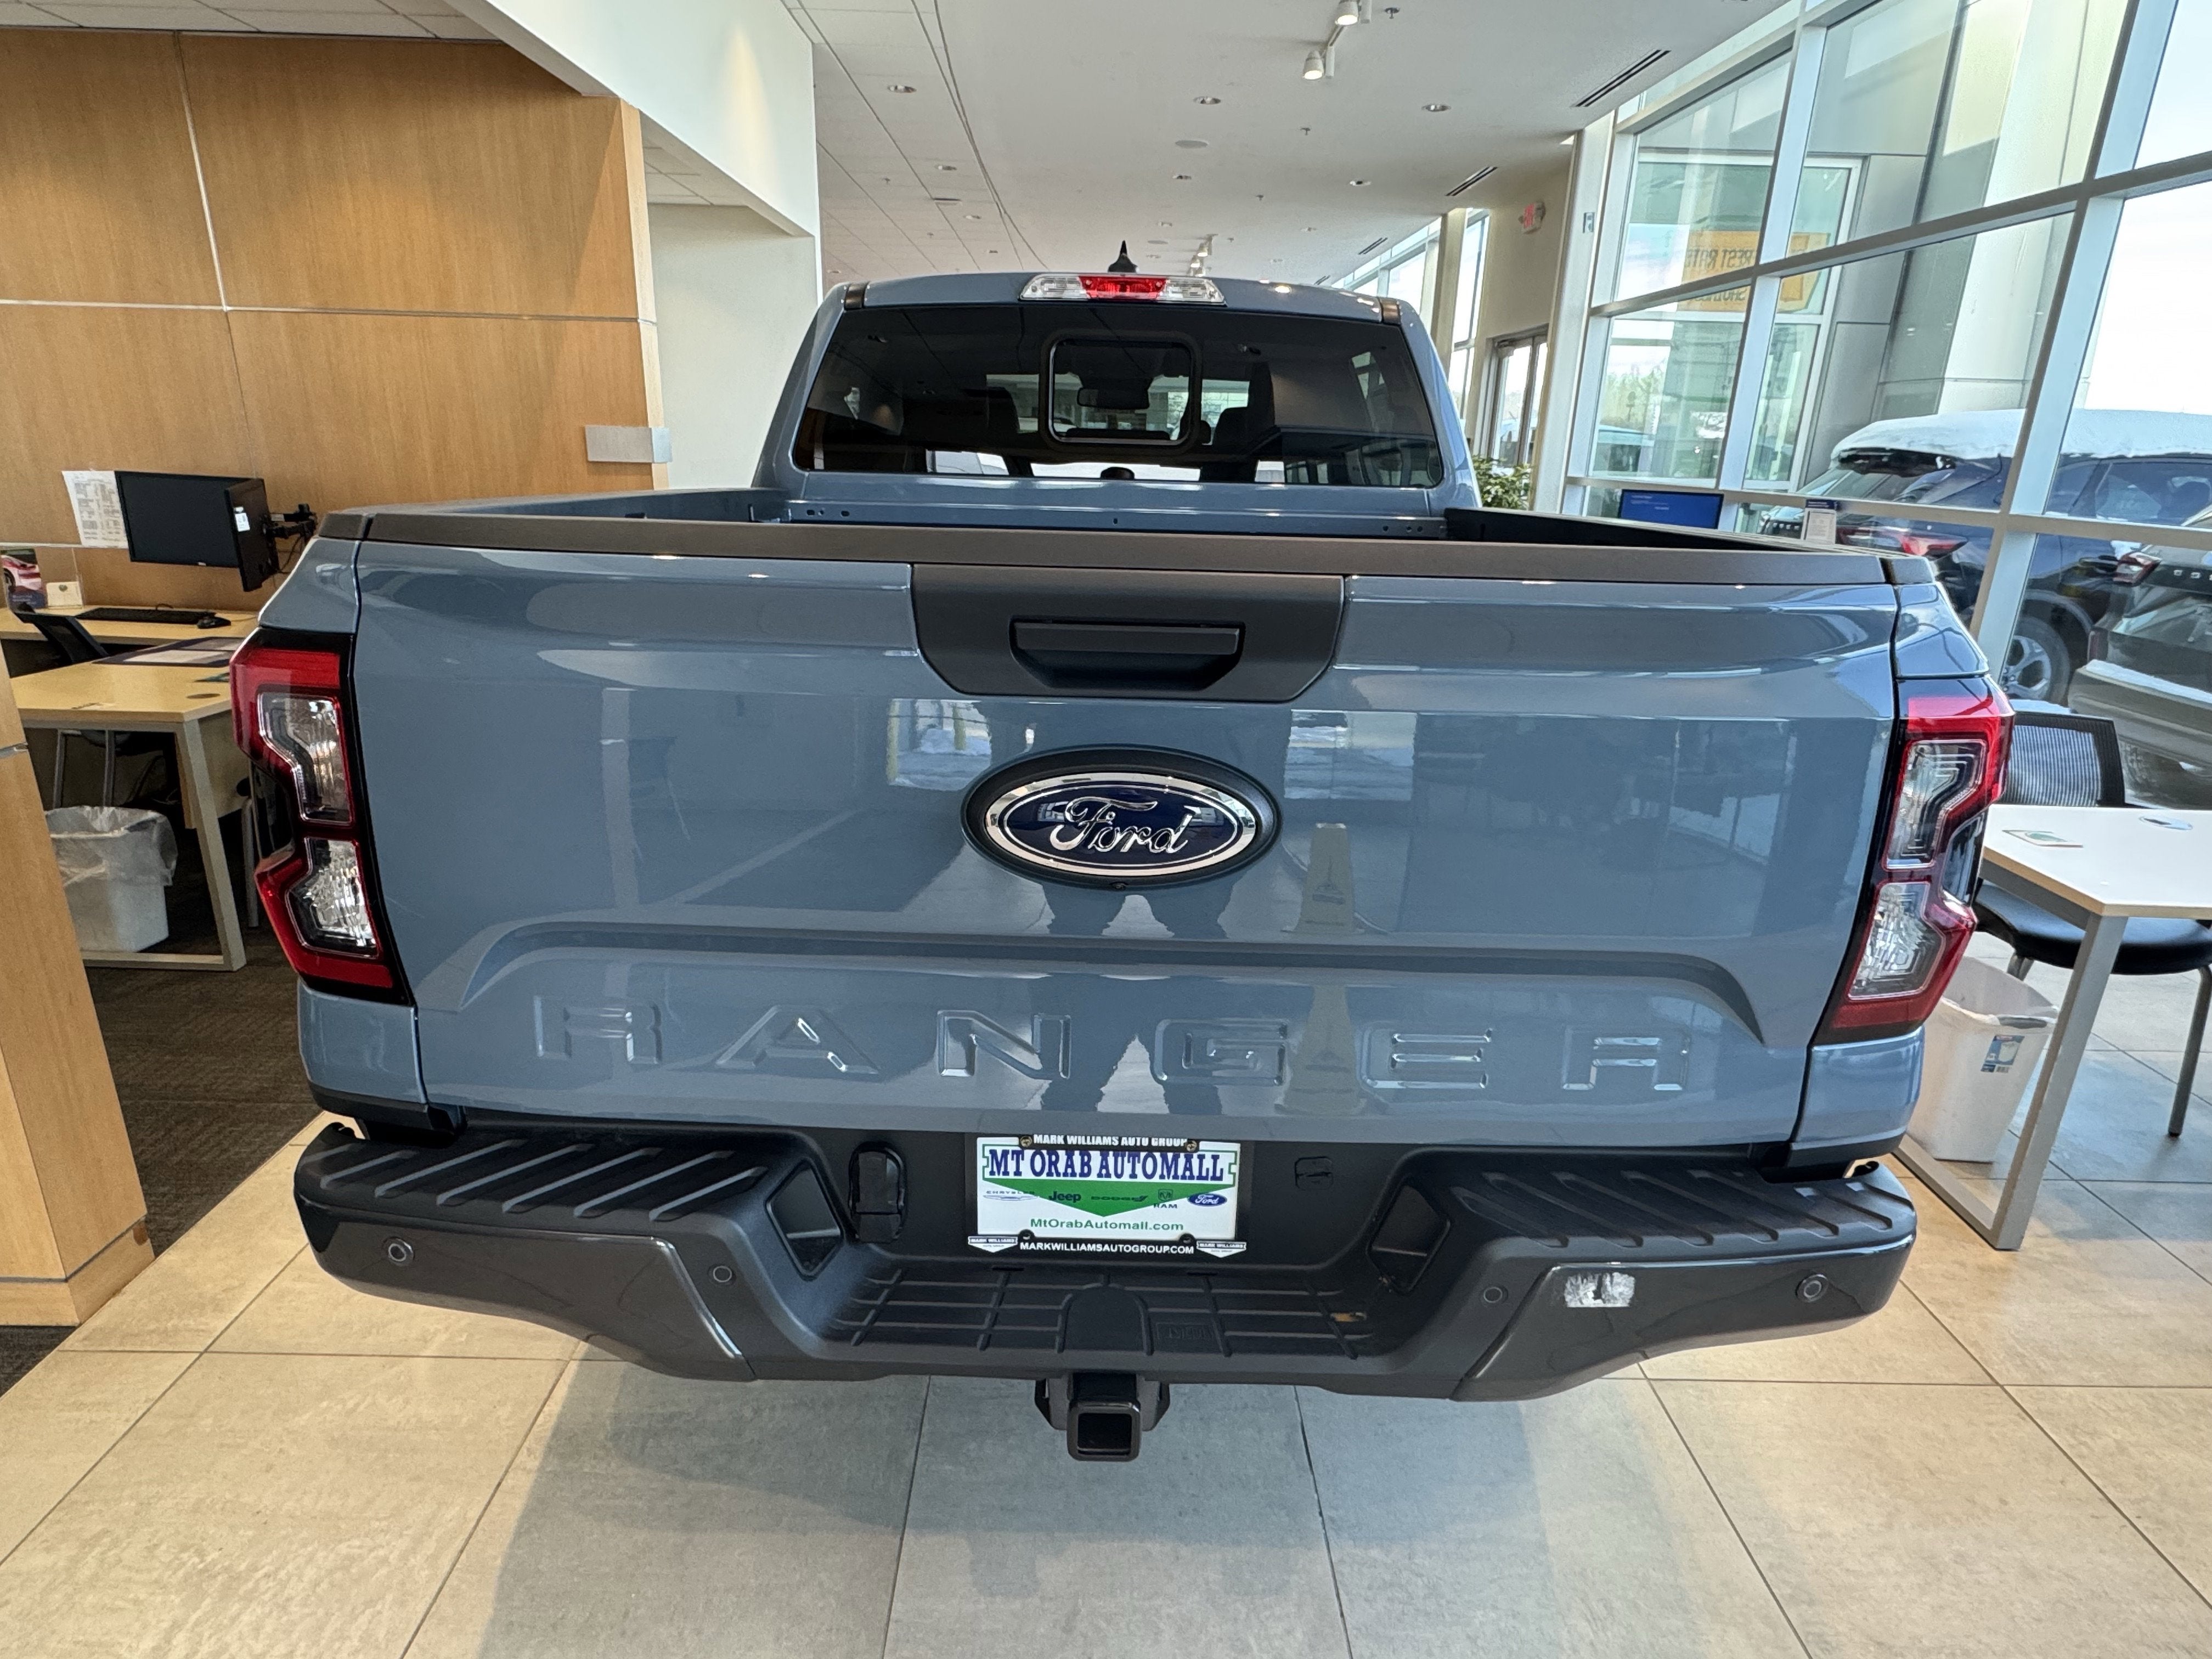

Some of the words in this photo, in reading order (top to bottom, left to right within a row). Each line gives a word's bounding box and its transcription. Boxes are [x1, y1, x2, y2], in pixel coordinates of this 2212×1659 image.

[1049, 795, 1192, 854] Ford
[533, 995, 1691, 1092] RANGER
[1033, 1134, 1064, 1144] MARK
[1066, 1135, 1119, 1146] WILLIAMS
[1121, 1137, 1149, 1147] AUTO
[1151, 1137, 1187, 1147] GROUP
[989, 1149, 1025, 1176] MT
[1030, 1150, 1092, 1178] ORAB
[1097, 1150, 1224, 1182] AUTOMALL
[1048, 1190, 1082, 1203] Jeep
[1194, 1194, 1220, 1205] Ford
[1030, 1218, 1184, 1231] MtOrabAutomall.com
[1019, 1242, 1194, 1255] MARKWILLIAMSAUTOGROUP.COM
